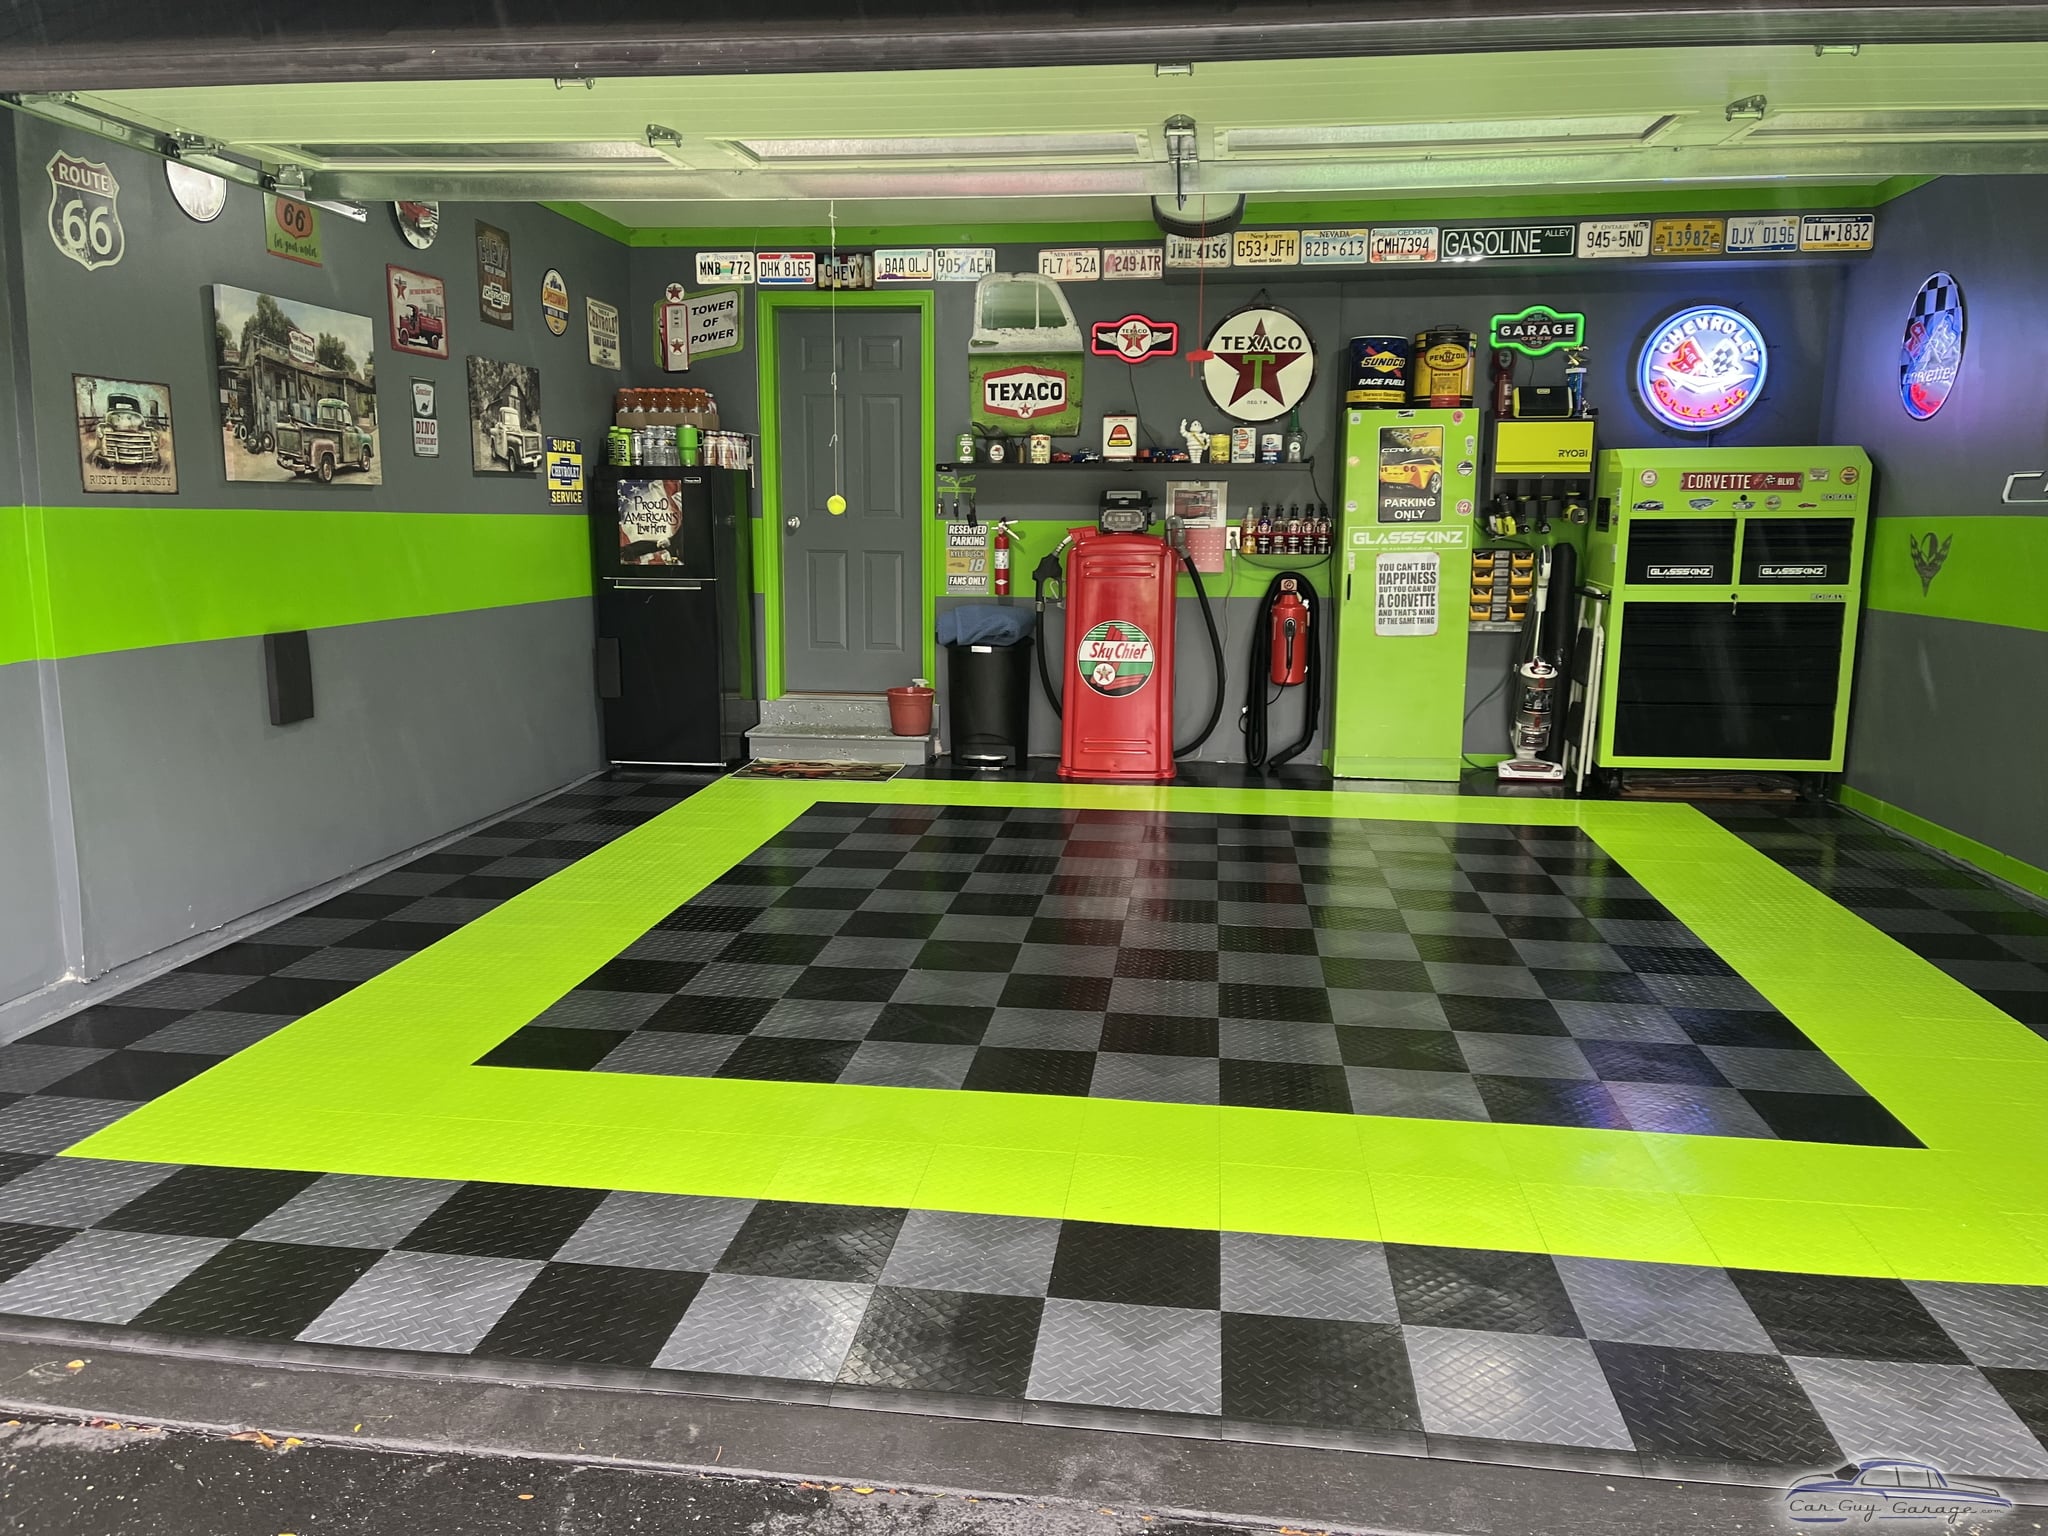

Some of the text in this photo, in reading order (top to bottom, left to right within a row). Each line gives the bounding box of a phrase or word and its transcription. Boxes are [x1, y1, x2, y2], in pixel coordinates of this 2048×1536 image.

[58, 162, 110, 192] ROUTE
[284, 203, 305, 232] 66
[62, 199, 112, 255] 66
[1805, 224, 1869, 241] LLW 1832
[1445, 229, 1570, 255] GASOLINE ALLEY
[1587, 231, 1611, 248] 945
[1667, 231, 1710, 247] 13982
[1732, 228, 1754, 244] DJX
[1237, 240, 1294, 257] G53 JFH
[1305, 241, 1364, 257] 82B 613
[1376, 237, 1429, 254] CMH7394
[700, 261, 751, 275] MNB 772
[760, 261, 811, 277] DHK 8165
[825, 263, 864, 281] CHEVY
[885, 257, 905, 273] BAA
[938, 257, 993, 273] 905 AEW
[1042, 257, 1097, 274] FL7 52A
[691, 300, 734, 316] TOWER
[703, 317, 719, 328] OF
[1500, 324, 1575, 336] GARAGE
[691, 329, 734, 344] POWER
[1221, 336, 1302, 352] TEXACO
[1660, 315, 1760, 363] CHEVROLET
[1363, 358, 1405, 367] SUNOCO
[1429, 353, 1466, 361] PENNZOIL
[1359, 378, 1406, 386] RACE FUELS
[987, 382, 1063, 401] TEXACO
[415, 421, 436, 435] DINO
[552, 439, 576, 453] SUPER
[1558, 449, 1588, 458] RYOBI
[551, 465, 580, 478] CHEVROLET
[89, 475, 172, 487] RUSTY BUT TRUSTY
[1687, 474, 1795, 489] CORVETTE BLVD
[551, 491, 583, 503] SERVICE
[1384, 498, 1436, 508] PARKING
[1394, 510, 1426, 519] ONLY
[948, 525, 988, 535] RESERVED
[951, 536, 985, 546] PARKING
[1353, 531, 1464, 545] GLASSSKINZ
[969, 558, 986, 572] 18
[1378, 562, 1437, 572] YOU CAN'T BUY
[949, 576, 987, 586] FANS ONLY
[1378, 571, 1437, 585] HAPPINESS
[1407, 585, 1421, 593] CAN
[1422, 585, 1436, 593] BUY
[1378, 593, 1436, 608] A CORVETTE
[1378, 609, 1392, 617] AND
[1418, 608, 1435, 616] KIND
[1089, 642, 1149, 660] Sky Chief
